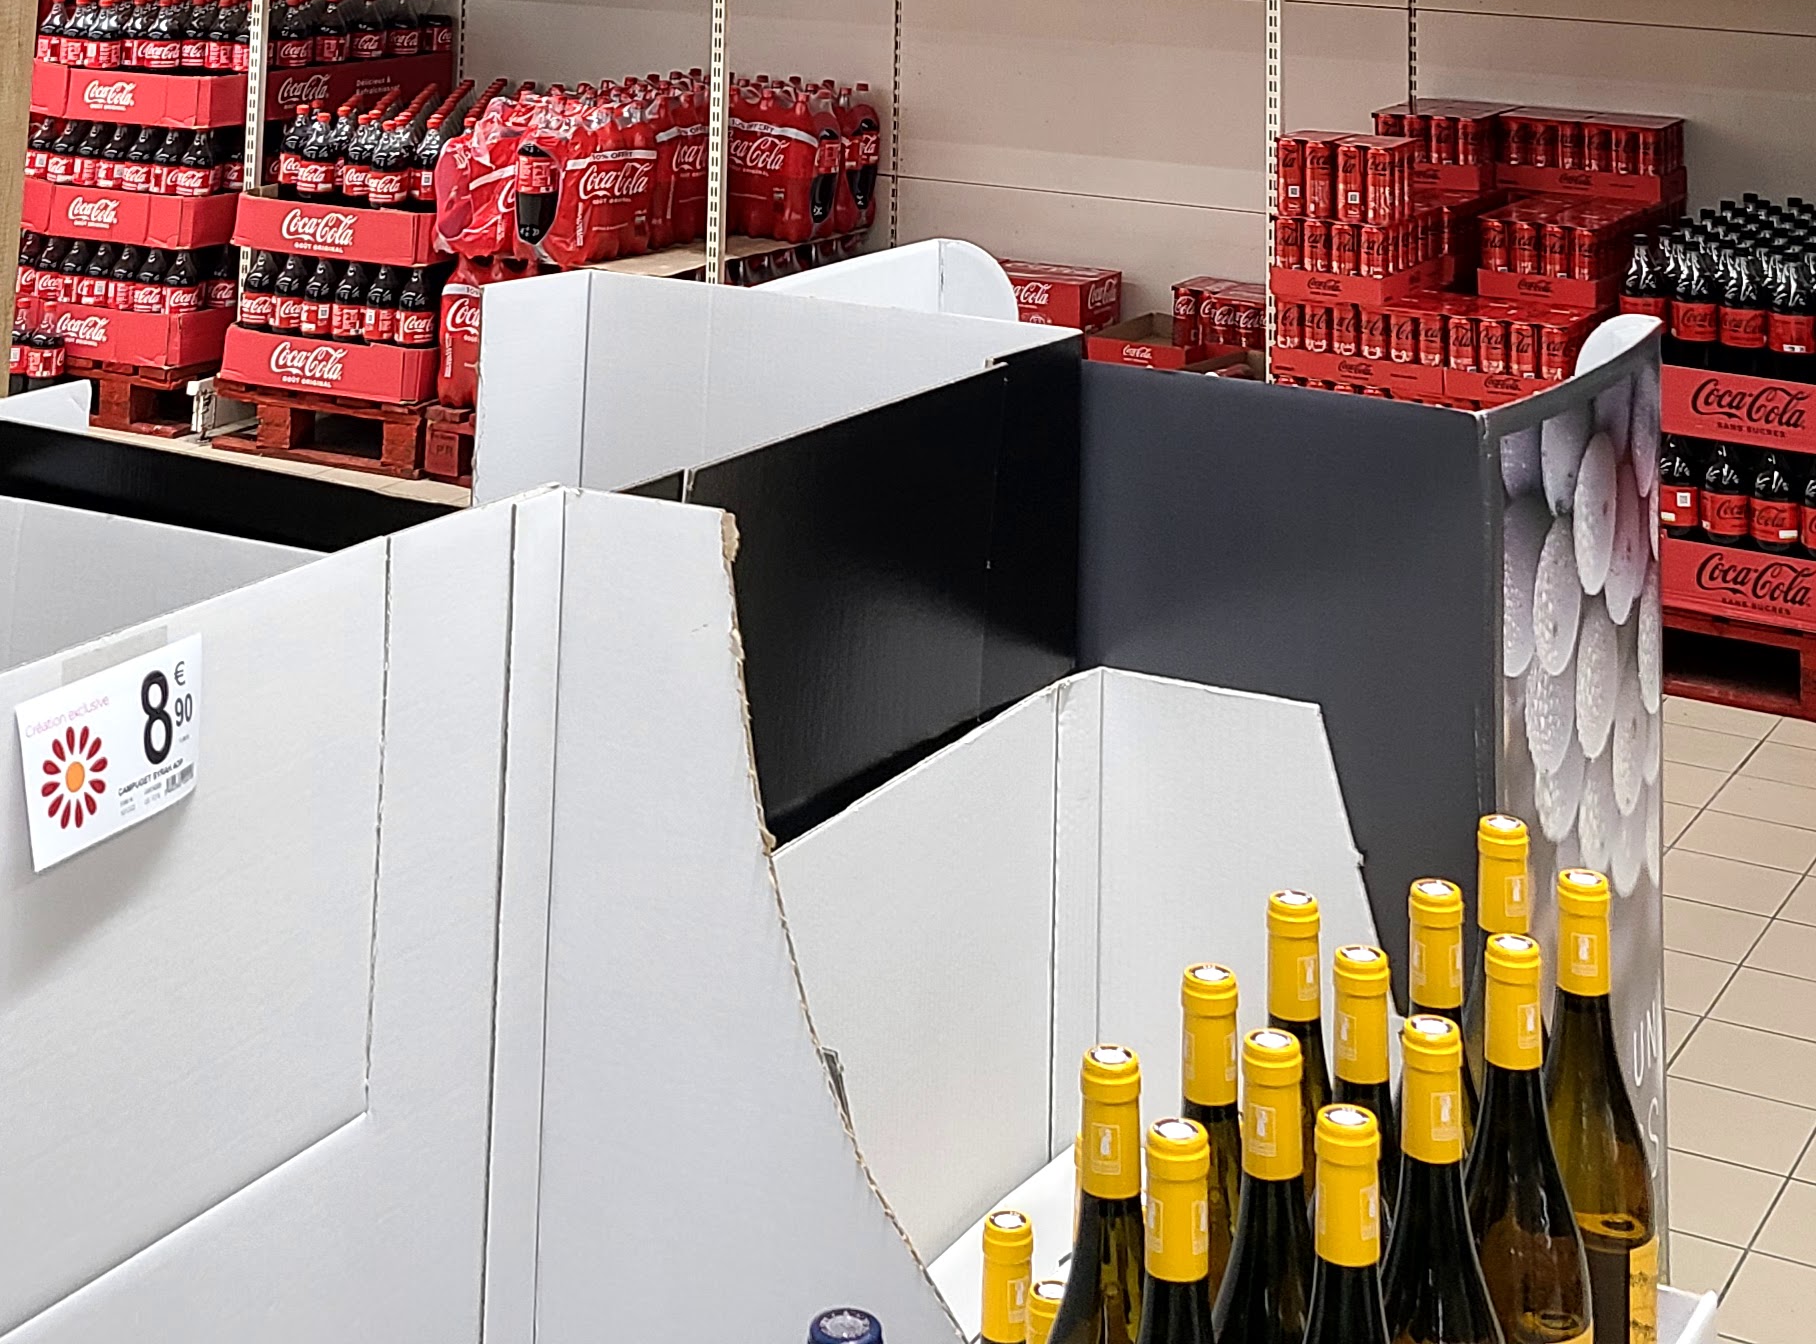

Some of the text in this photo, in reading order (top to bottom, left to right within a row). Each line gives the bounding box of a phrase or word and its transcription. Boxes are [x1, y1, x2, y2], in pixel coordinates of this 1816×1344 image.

[281, 208, 359, 246] Coca-Cola
[270, 341, 348, 381] Coca-Cola
[1691, 378, 1811, 430] Coca-Cola
[1717, 421, 1787, 439] SANS SUCRES
[1696, 552, 1816, 607] Coca-Cola
[1721, 597, 1792, 616] SANS SUCRES
[25, 695, 111, 739] Création exclusive
[141, 670, 174, 765] 8
[174, 693, 194, 728] 90
